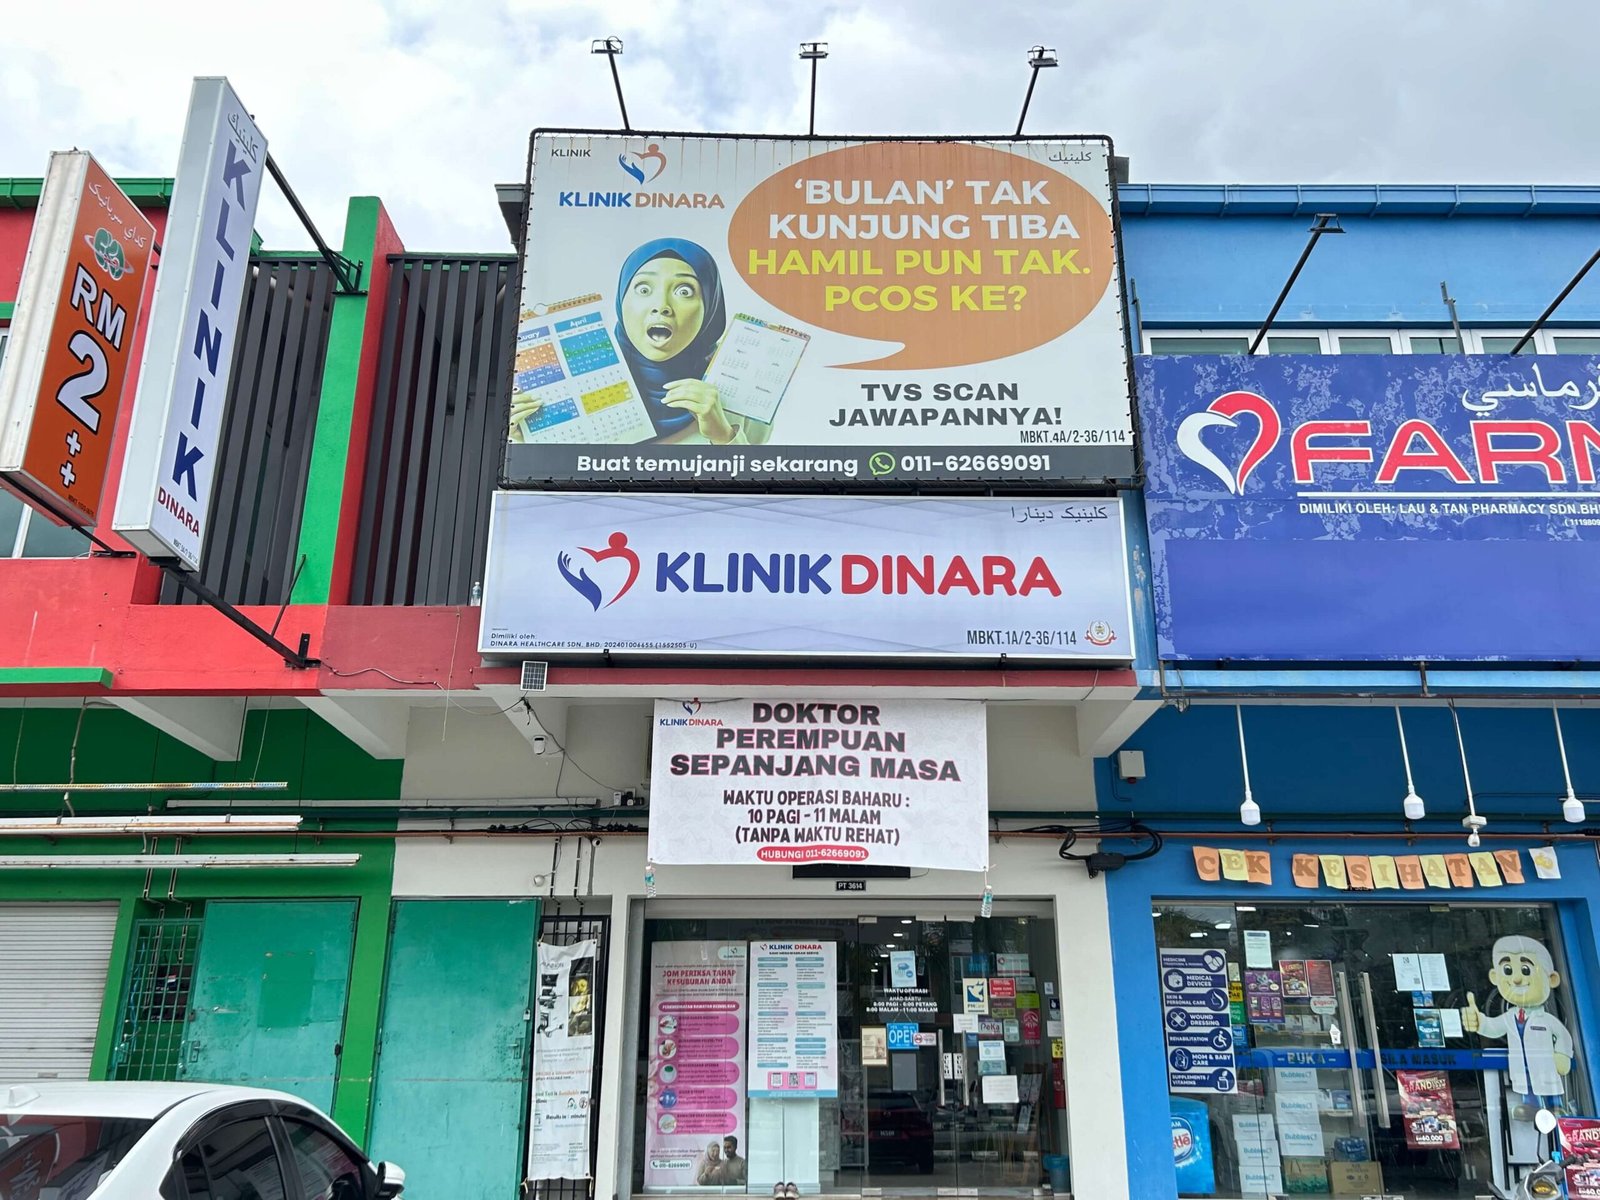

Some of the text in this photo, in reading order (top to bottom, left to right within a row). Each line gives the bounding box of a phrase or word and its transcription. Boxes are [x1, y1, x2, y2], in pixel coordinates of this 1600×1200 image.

[551, 148, 591, 158] KLINIK
[559, 191, 725, 209] KLINIK DINARA
[965, 180, 1050, 205] TAK
[768, 214, 1080, 240] KUNJUNG TIBA
[748, 249, 1091, 275] HAMIL PUN TAK.
[71, 263, 127, 351] RM
[825, 285, 1027, 312] PCOS KE?
[172, 139, 252, 502] KLINIK
[57, 330, 108, 433] 2
[861, 383, 1018, 401] TVS SCAN
[829, 407, 1062, 426] JAWAPANNYA!
[1020, 430, 1125, 443] MBKT.4A/2-36/114
[577, 455, 1050, 477] Buat temujanji sekarang 011-62669091
[157, 486, 200, 537] DINARA
[1299, 503, 1600, 515] DIMILIKI OLEH: LAU & TAN PHARMACY SDN.BH
[656, 552, 1062, 597] KLINIK DINARA
[967, 630, 1077, 646] MBKT.1A/2-36/114
[659, 718, 724, 727] KLINIK DINARA
[752, 703, 880, 725] DOKTOR
[716, 729, 905, 752] PEREMPUAN
[670, 754, 961, 782] SEPANJANG MASA
[723, 790, 775, 805] WAKTU
[777, 790, 839, 806] OPERASI
[842, 791, 902, 807] BAHARU
[748, 809, 763, 823] 10
[766, 809, 800, 824] PAGI
[813, 808, 826, 823] 11
[829, 809, 881, 825] MALAM
[735, 826, 899, 846] (TANPA WAKTU REHAT)
[761, 849, 866, 859] HUBUNGI 011-62669091
[1199, 852, 1522, 884] CEK KESIHATAN
[713, 969, 736, 977] TAHAP
